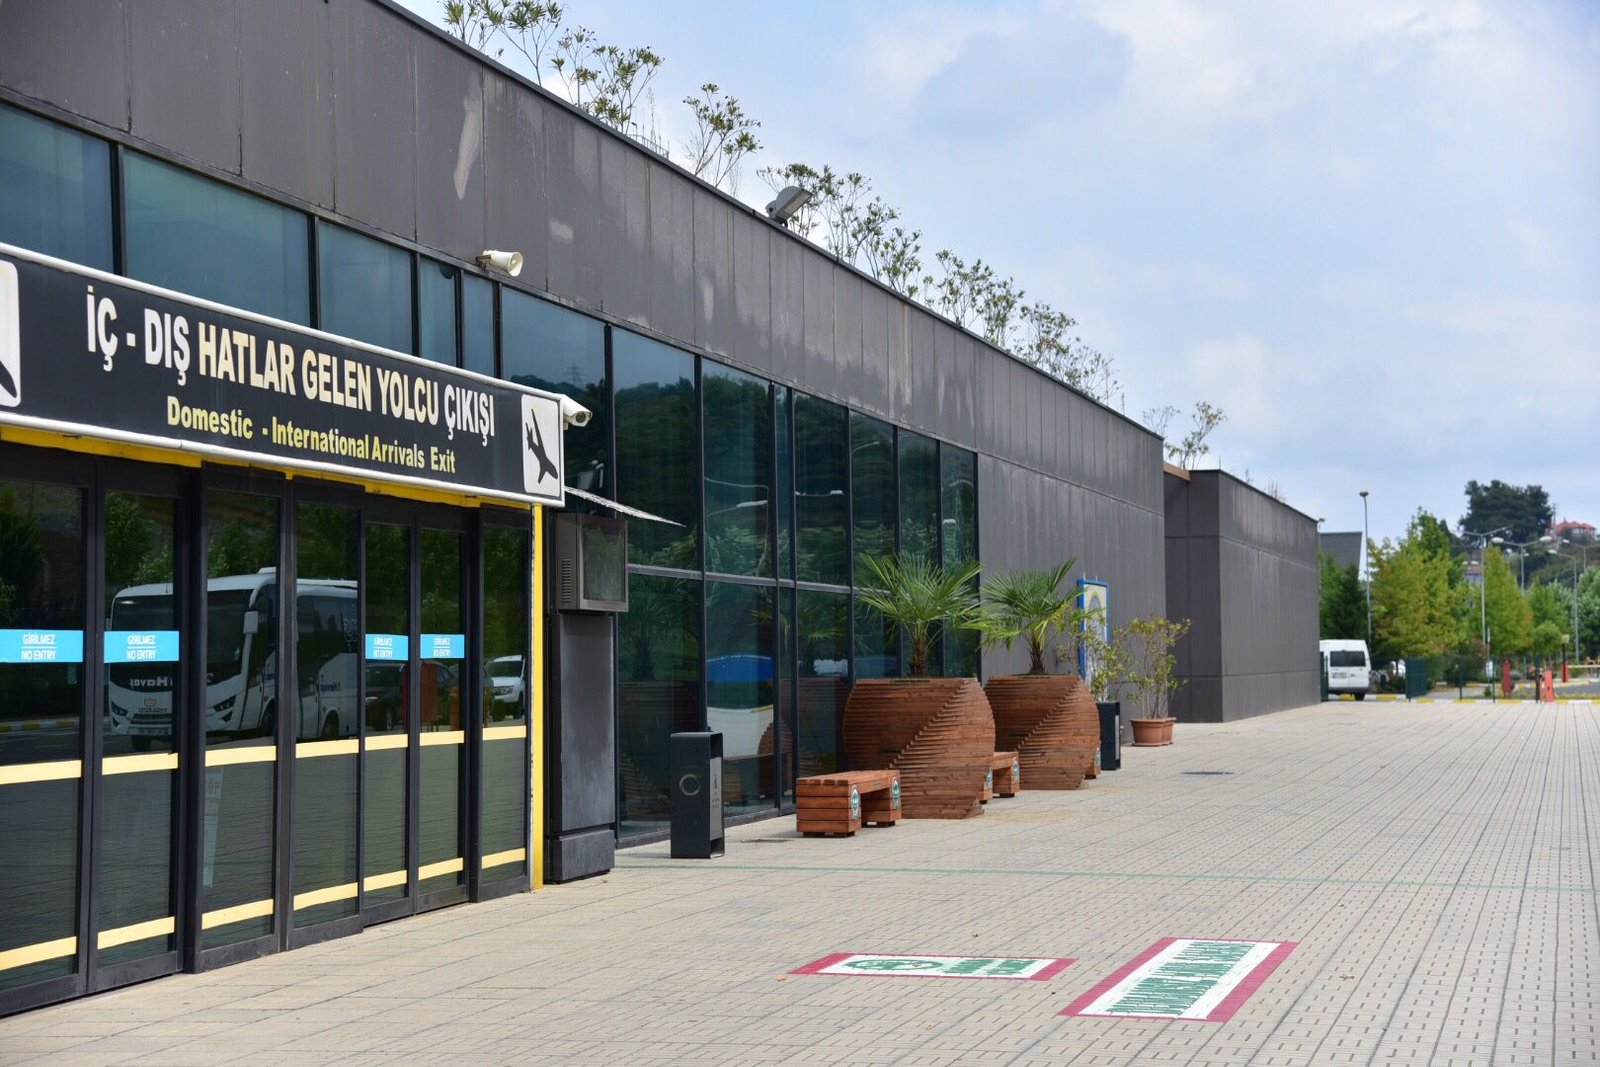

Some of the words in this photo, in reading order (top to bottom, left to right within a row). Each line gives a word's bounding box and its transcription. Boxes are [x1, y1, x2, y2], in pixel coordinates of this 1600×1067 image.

[86, 285, 118, 372] İÇ
[144, 308, 190, 386] DIŞ
[198, 321, 296, 395] HATLAR
[302, 349, 372, 412] GELEN
[376, 367, 439, 426] YOLCU
[444, 384, 495, 447] ÇIKIŞI
[167, 395, 253, 440] Domestic
[272, 416, 369, 460] International
[371, 436, 425, 469] Arrivals
[430, 446, 456, 474] Exit
[22, 649, 33, 660] NO
[33, 649, 56, 660] ENTRY
[127, 649, 137, 660] NO
[137, 649, 156, 660] ENTRY
